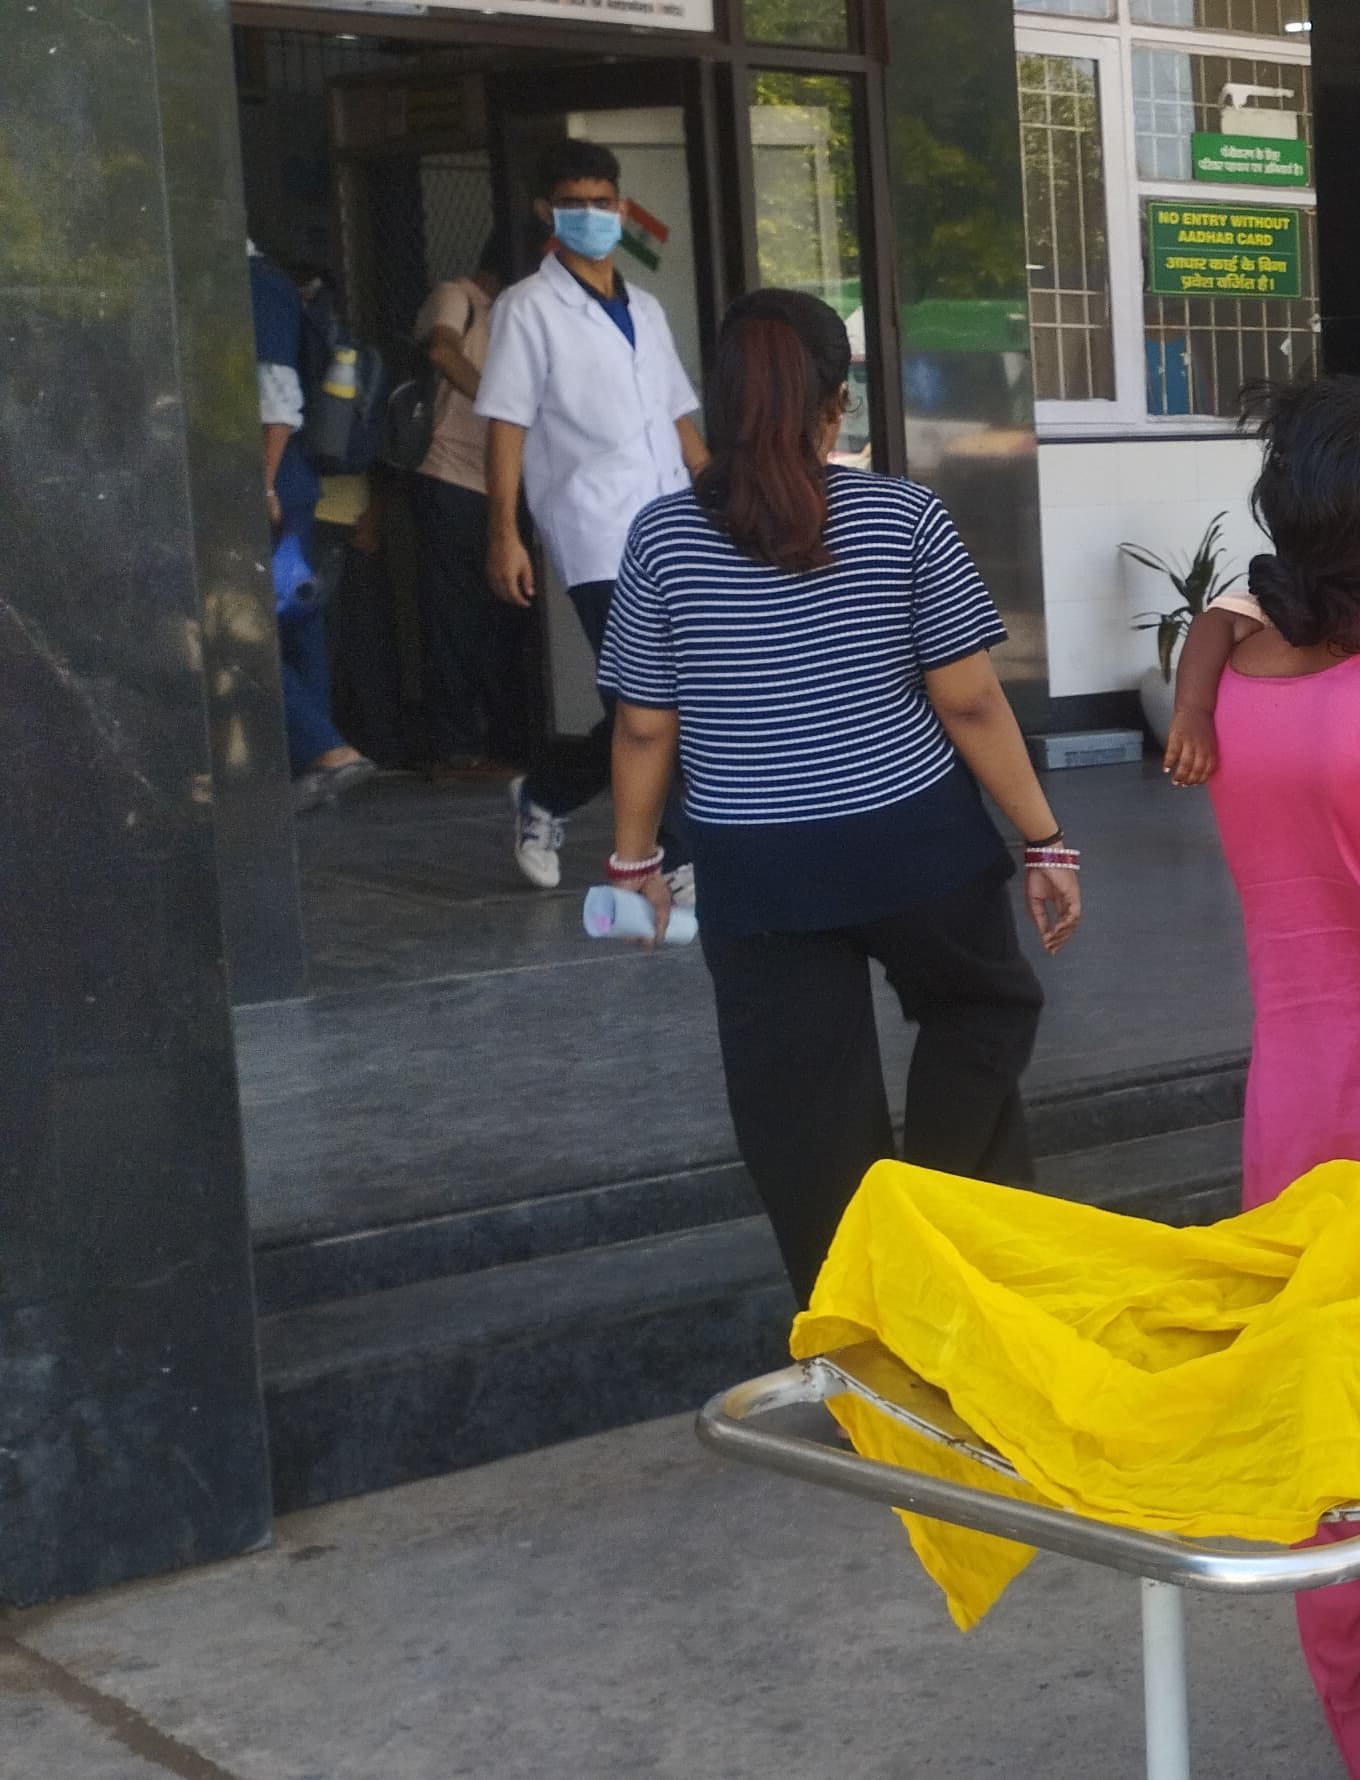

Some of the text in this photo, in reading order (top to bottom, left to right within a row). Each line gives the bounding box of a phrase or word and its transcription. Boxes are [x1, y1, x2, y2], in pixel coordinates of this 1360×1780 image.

[1158, 211, 1290, 230] NO ENTRY WITHOUT
[1178, 231, 1273, 246] AADHAR CARD
